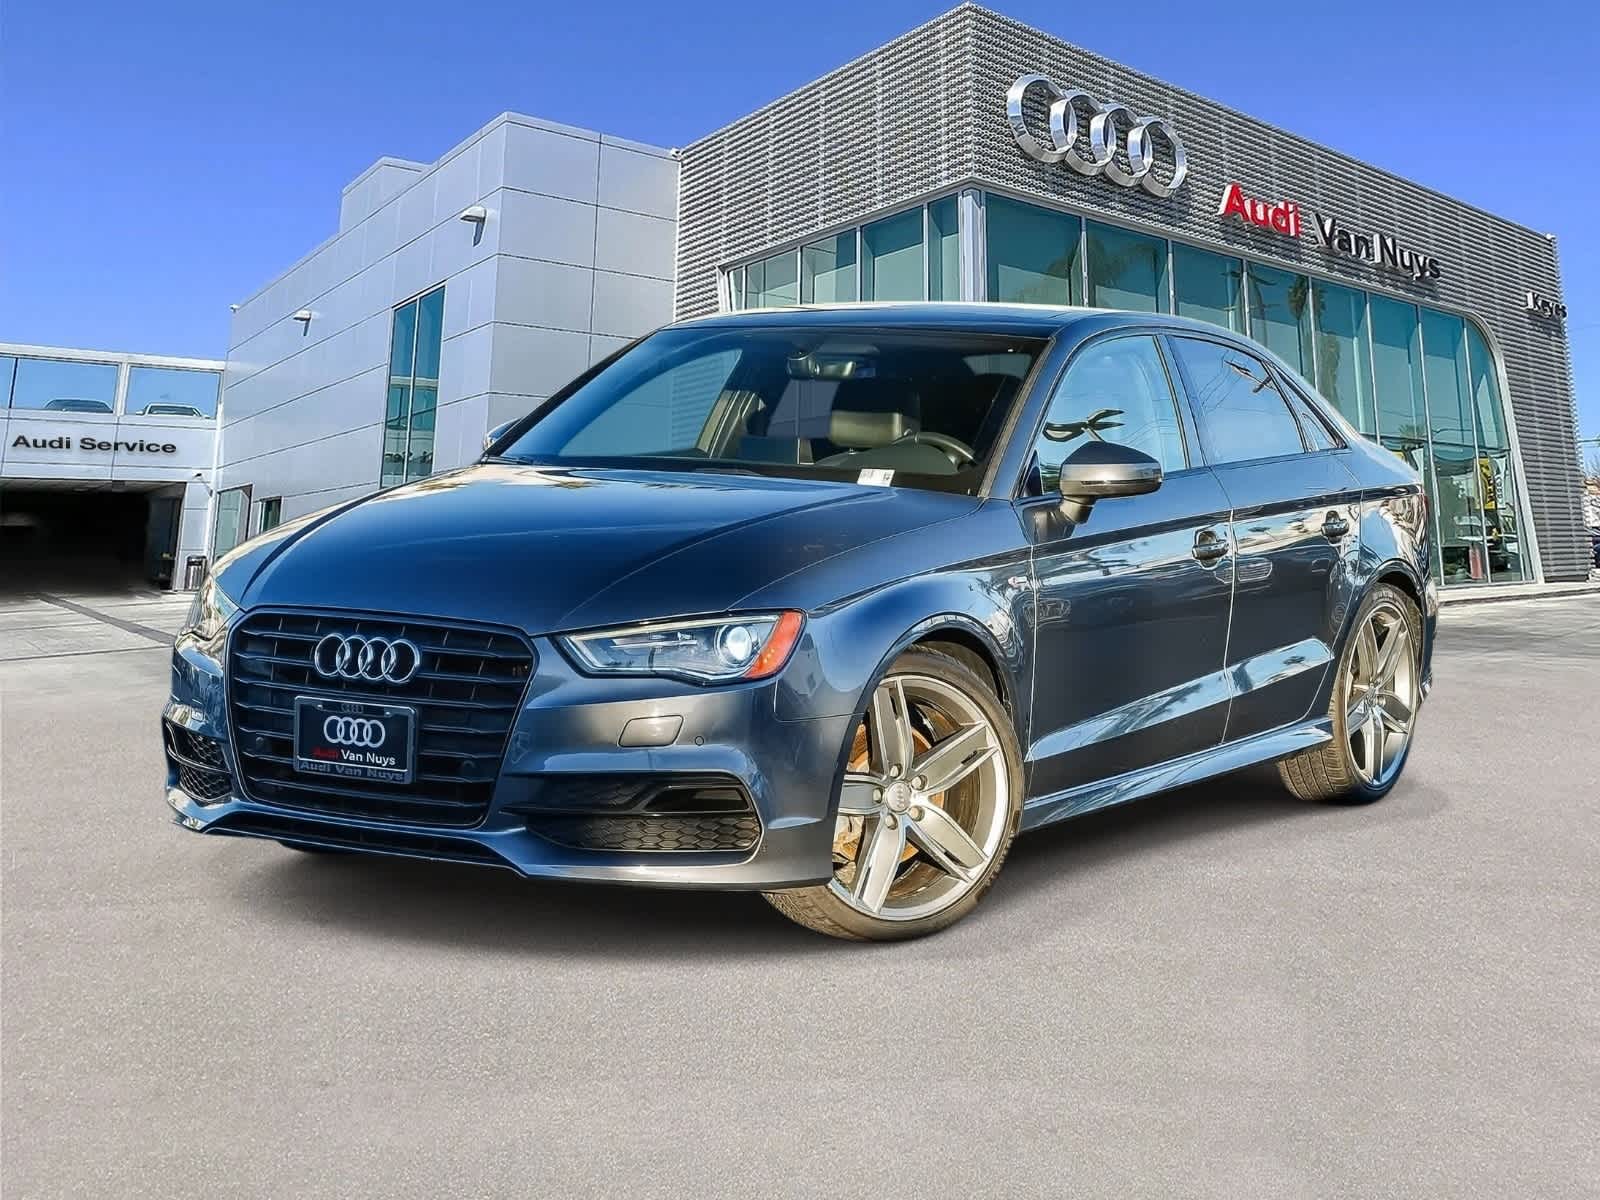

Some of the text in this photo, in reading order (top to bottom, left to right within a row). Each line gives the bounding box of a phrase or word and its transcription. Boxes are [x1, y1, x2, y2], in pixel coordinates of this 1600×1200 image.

[1218, 182, 1441, 282] Audi Van Nuys
[12, 434, 177, 454] Audi Service
[341, 748, 363, 762] Van
[366, 752, 396, 767] Nuys
[300, 760, 404, 782] Audi Van Nuys
